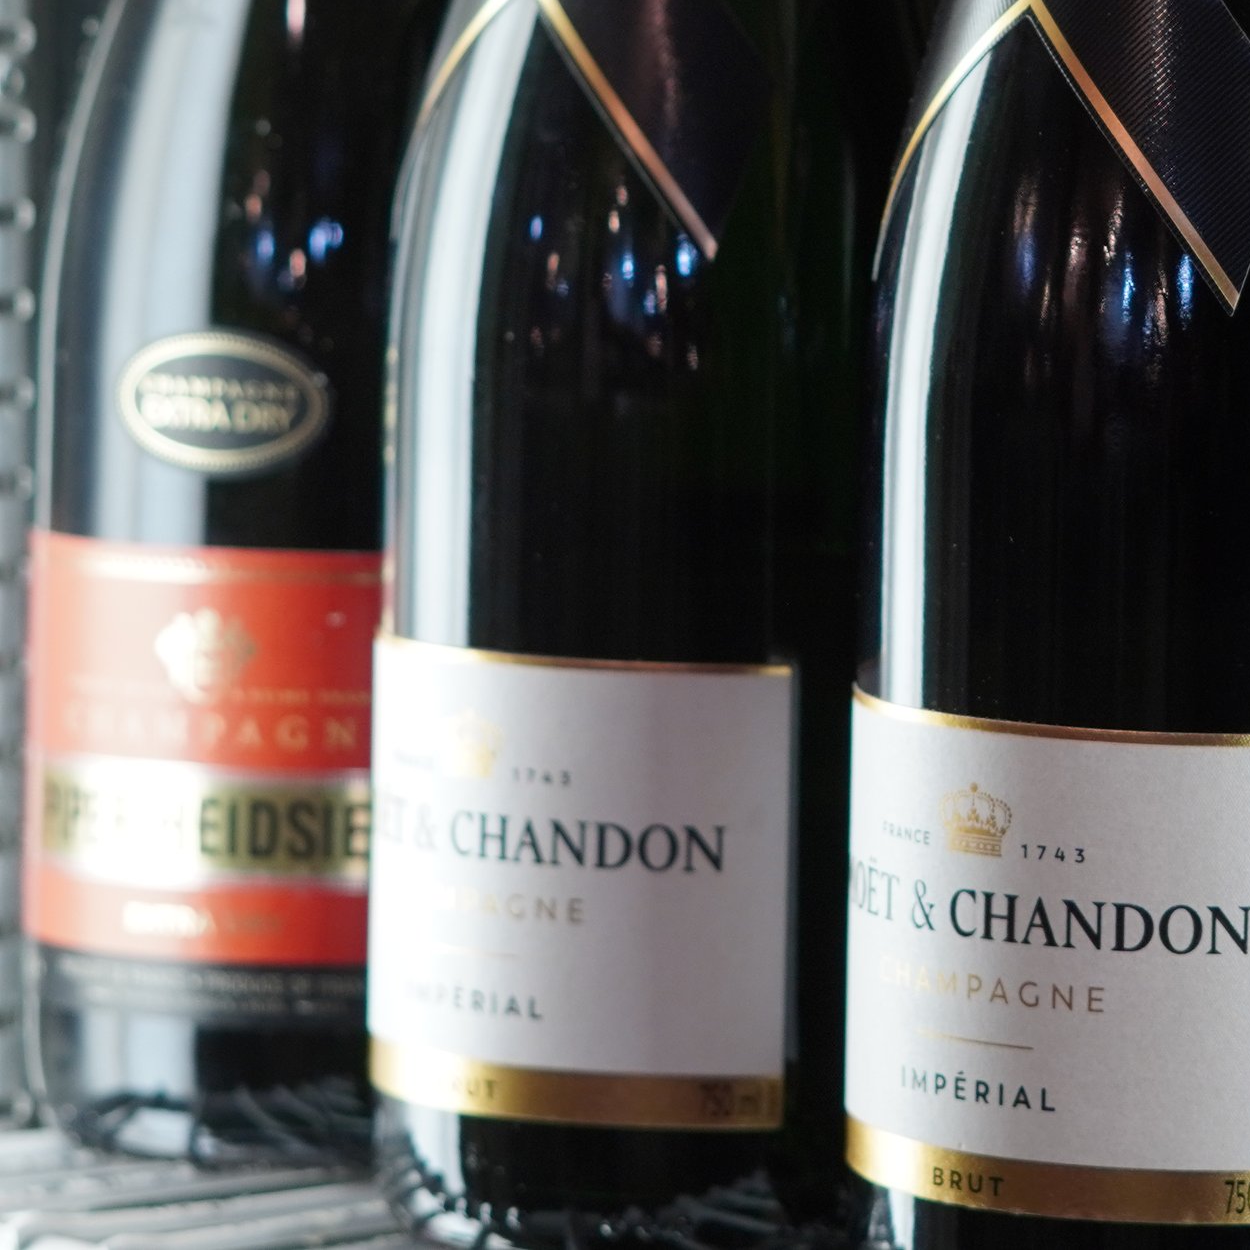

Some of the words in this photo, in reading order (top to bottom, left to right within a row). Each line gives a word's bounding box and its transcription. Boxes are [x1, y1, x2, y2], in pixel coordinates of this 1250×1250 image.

[450, 810, 727, 874] CHANDON
[881, 820, 931, 846] FRANCE
[1020, 844, 1086, 864] 1743
[911, 879, 936, 931] &
[880, 954, 1106, 1013] CHAMPAGNE
[900, 1065, 1057, 1113] IMPÉRIAL
[931, 1166, 1006, 1197] BRUT
